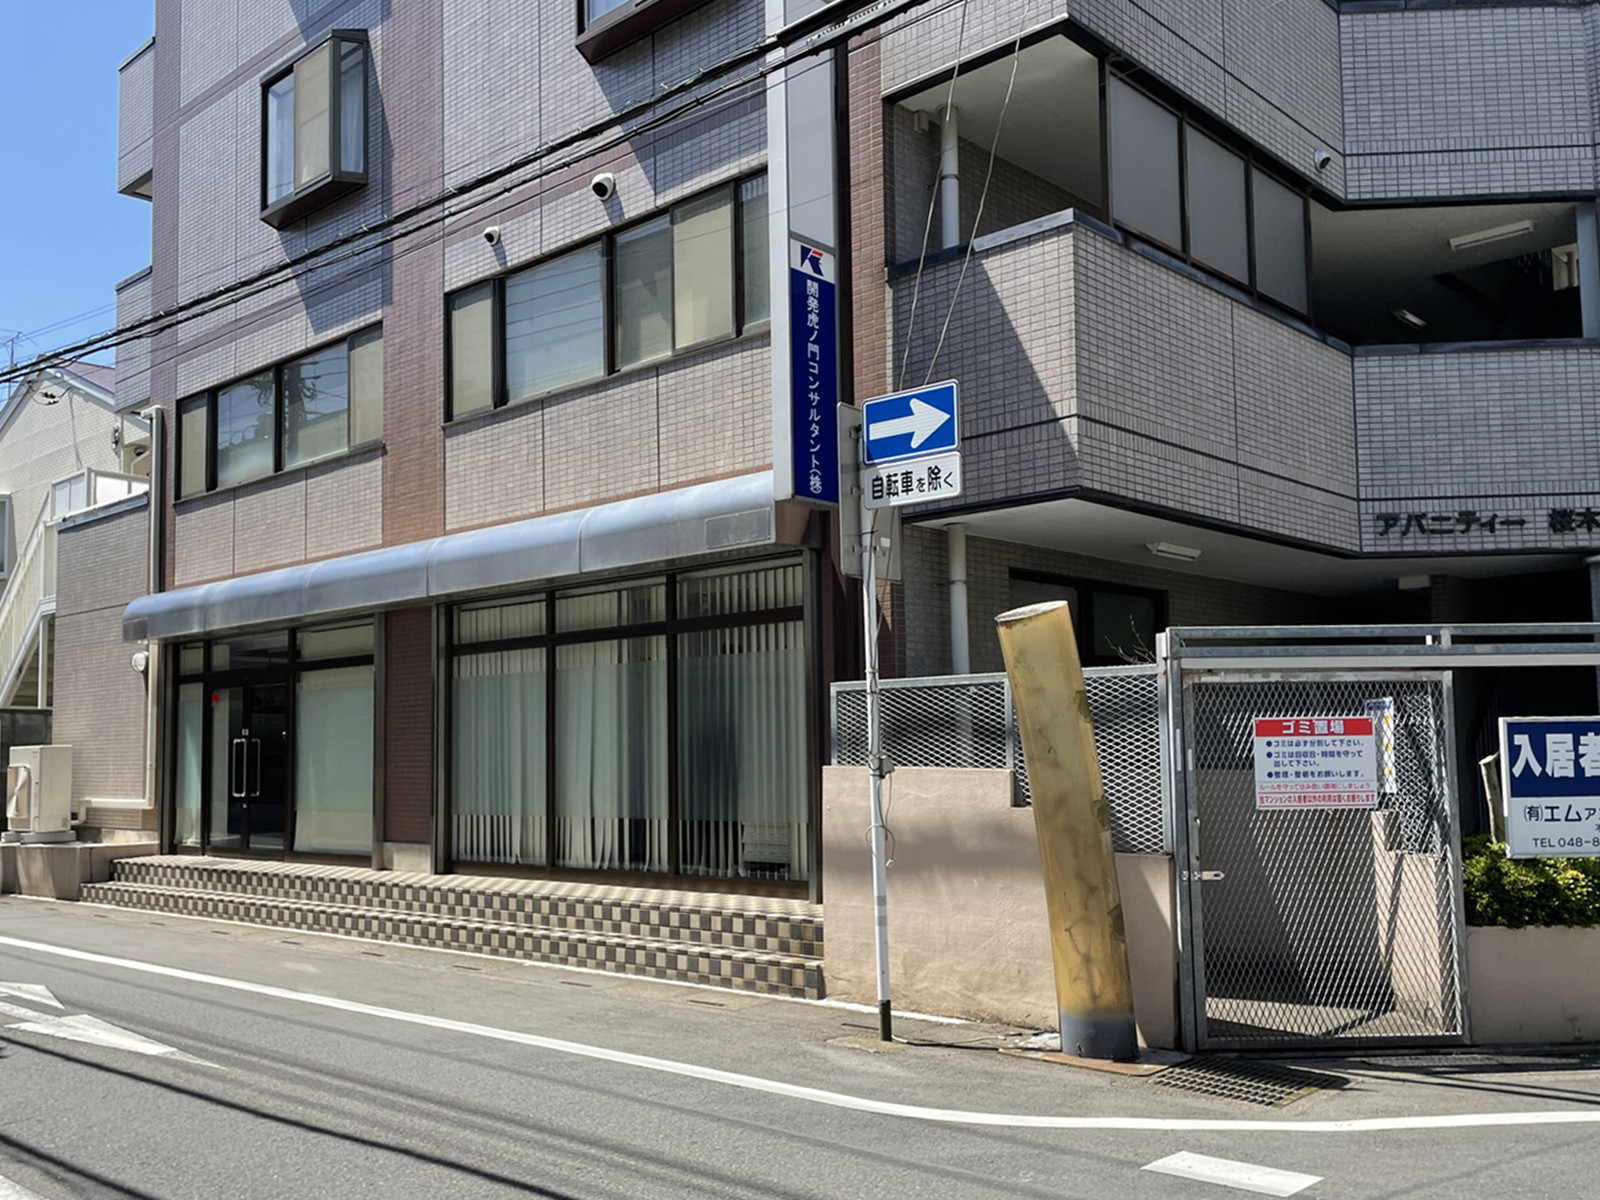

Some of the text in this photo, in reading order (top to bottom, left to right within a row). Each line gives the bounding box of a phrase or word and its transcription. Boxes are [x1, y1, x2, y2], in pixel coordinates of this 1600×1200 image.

[872, 465, 954, 500] 自転車を除く
[1282, 720, 1344, 734] ゴミ置場
[1511, 732, 1600, 778] 入居者
[1523, 804, 1600, 822] (有)エムア
[1532, 838, 1555, 848] TEL
